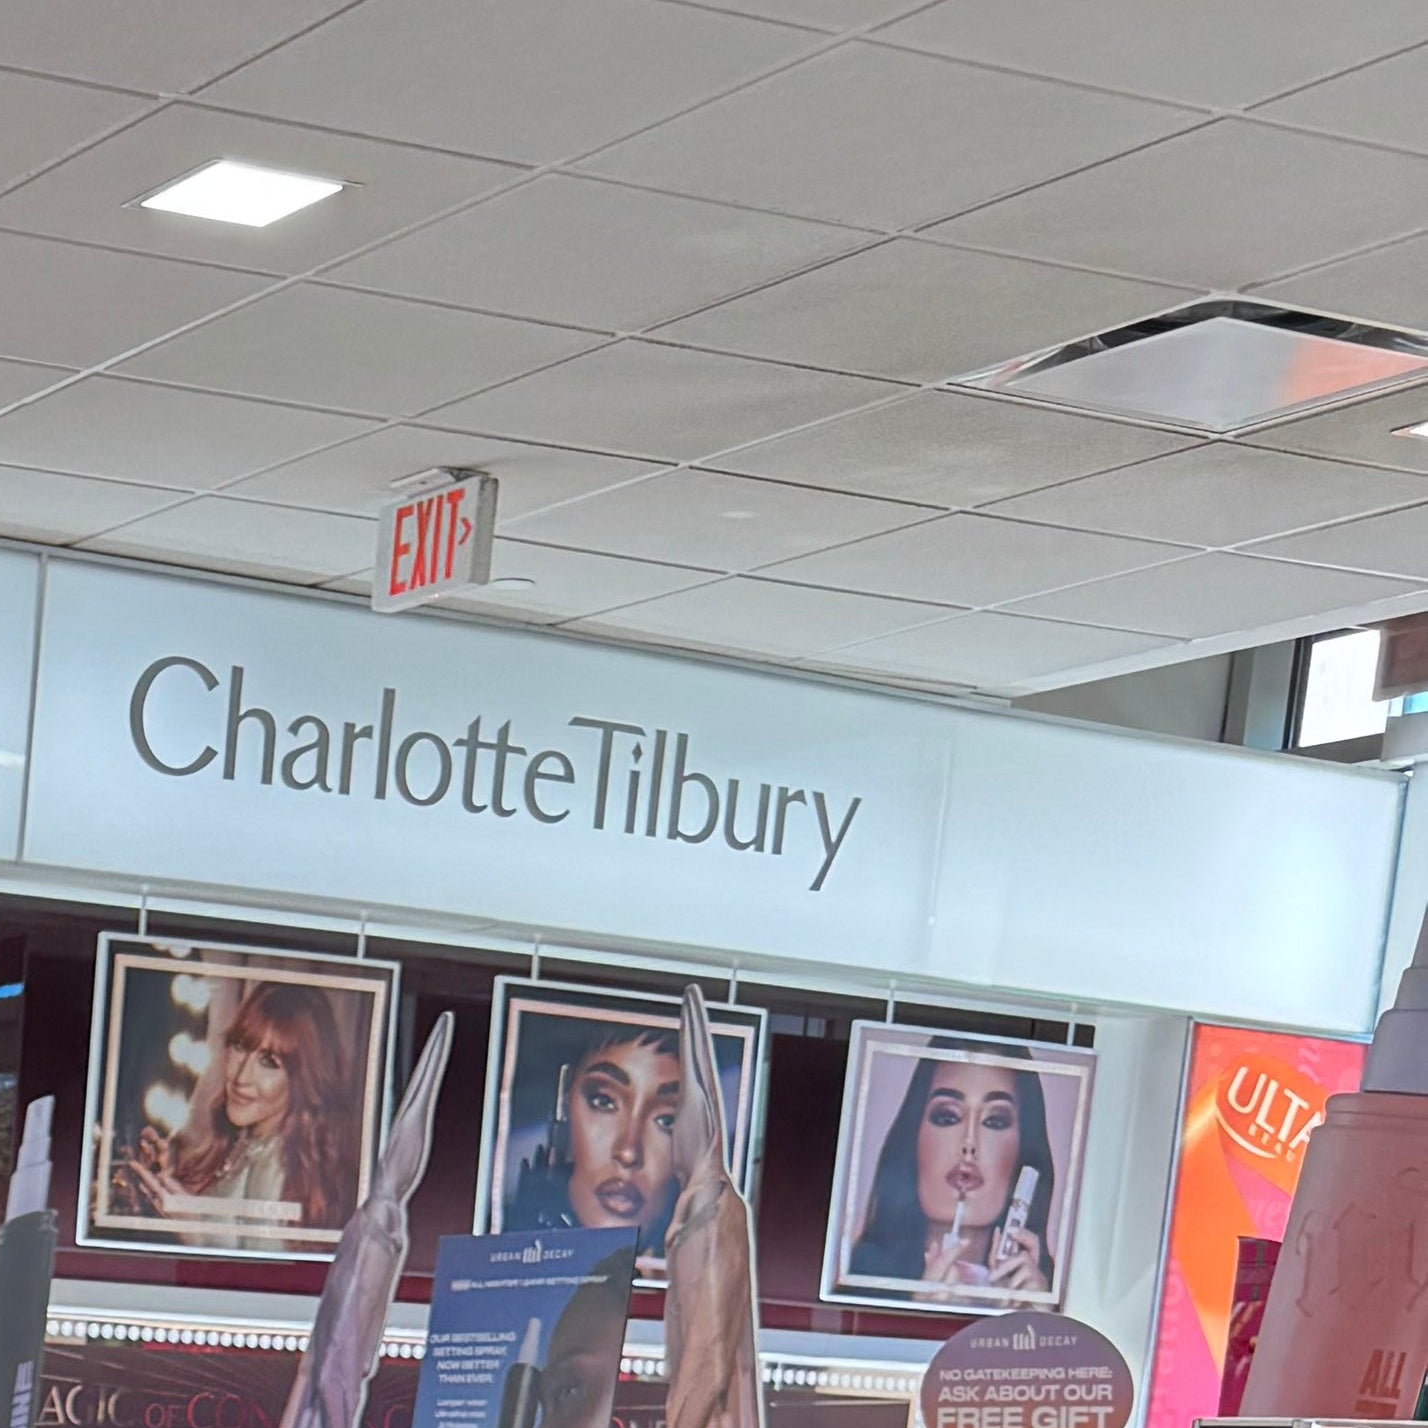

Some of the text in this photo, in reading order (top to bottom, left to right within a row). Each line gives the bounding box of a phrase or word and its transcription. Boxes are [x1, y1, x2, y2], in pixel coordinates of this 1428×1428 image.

[389, 489, 465, 597] EXIT
[970, 1335, 1078, 1349] URBAN DECAY
[939, 1366, 1113, 1381] NO GATEKEEPING HERE:
[938, 1384, 1113, 1402] ASK ABOUT OUR
